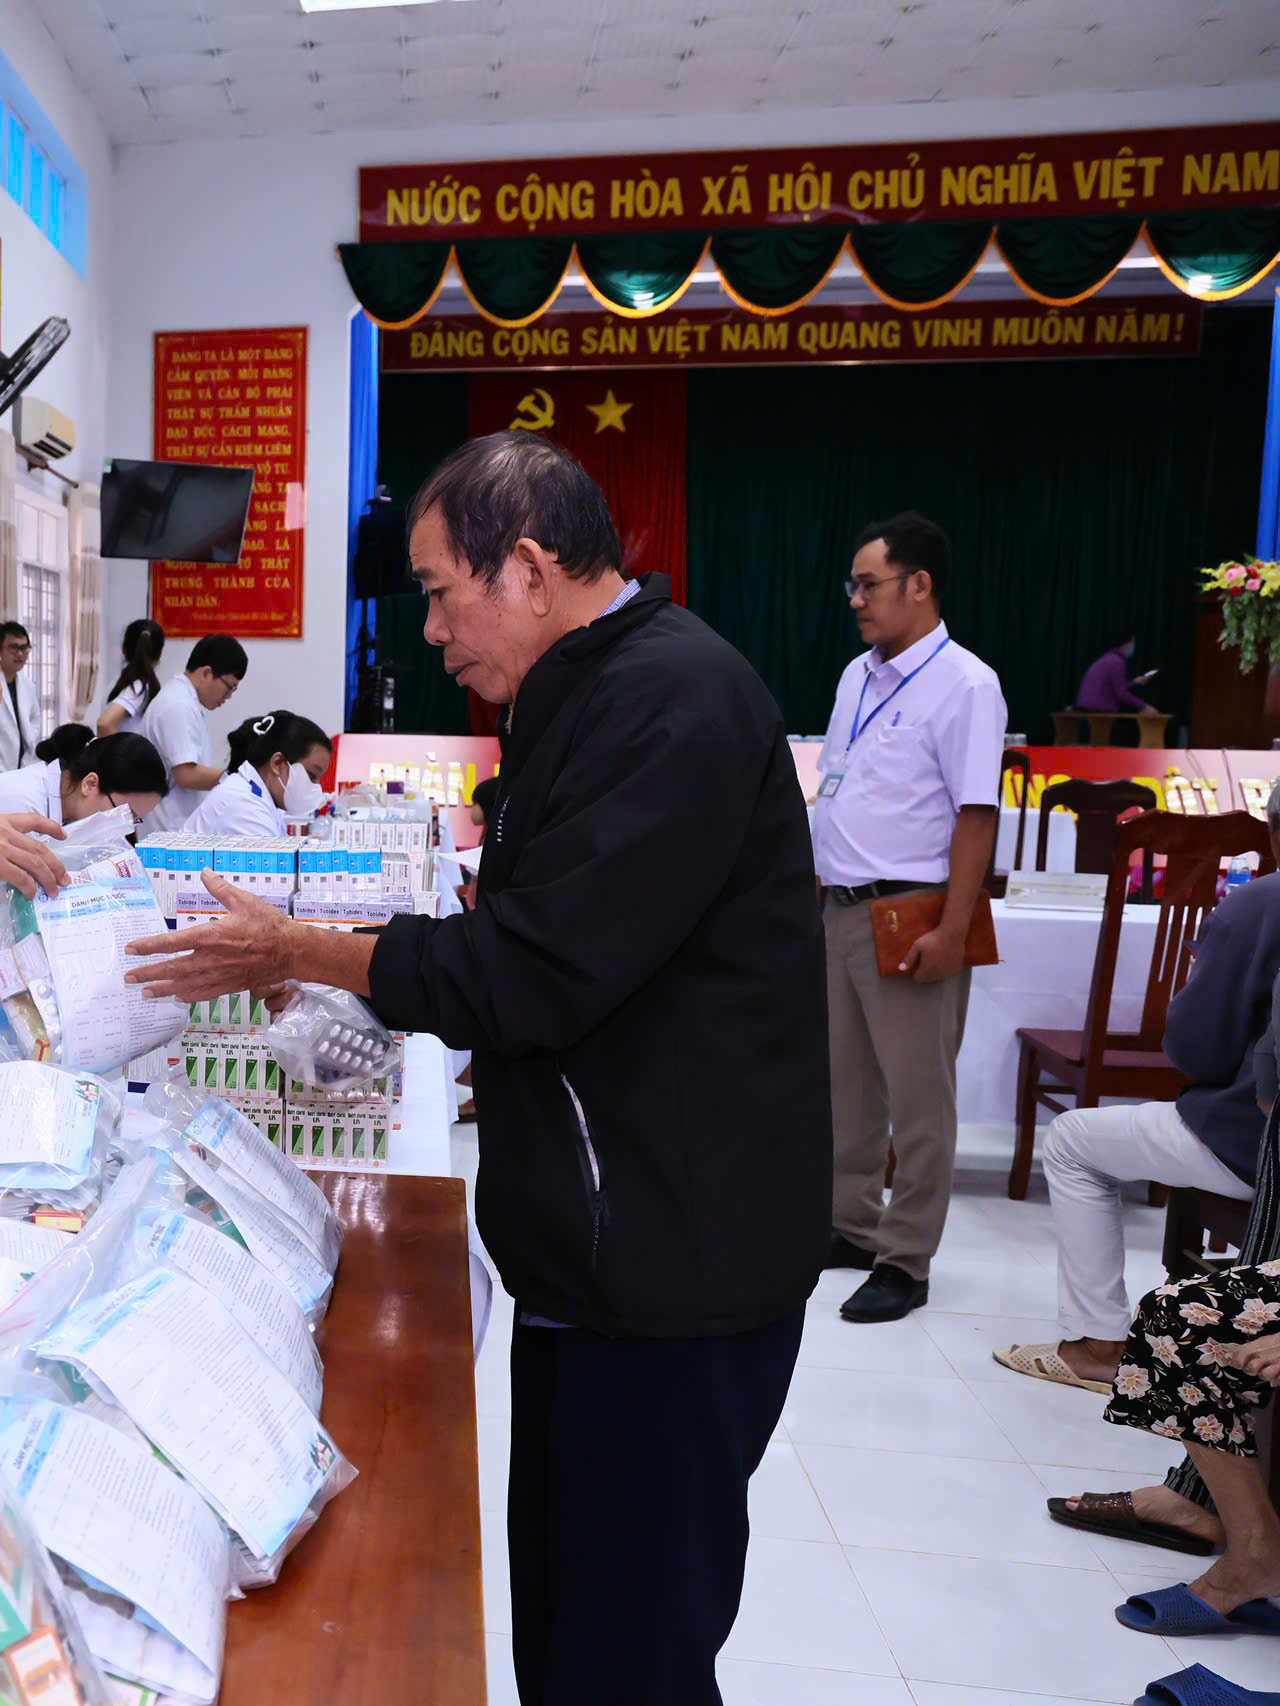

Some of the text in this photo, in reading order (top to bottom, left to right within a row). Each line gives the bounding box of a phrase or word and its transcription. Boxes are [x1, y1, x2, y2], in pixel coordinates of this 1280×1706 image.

[386, 146, 1280, 231] NƯỚC CỘNG HÒA XÃ HỘI CHỦ NGHĨA VIỆT NAM
[410, 320, 485, 359] ĐẢNG
[492, 325, 570, 363] CỘNG
[579, 316, 638, 355] SẢN
[647, 318, 712, 359] VIỆT
[720, 323, 789, 353] NAM
[798, 320, 901, 355] QUANG
[912, 318, 983, 348] VINH
[992, 310, 1086, 347] MUÔN
